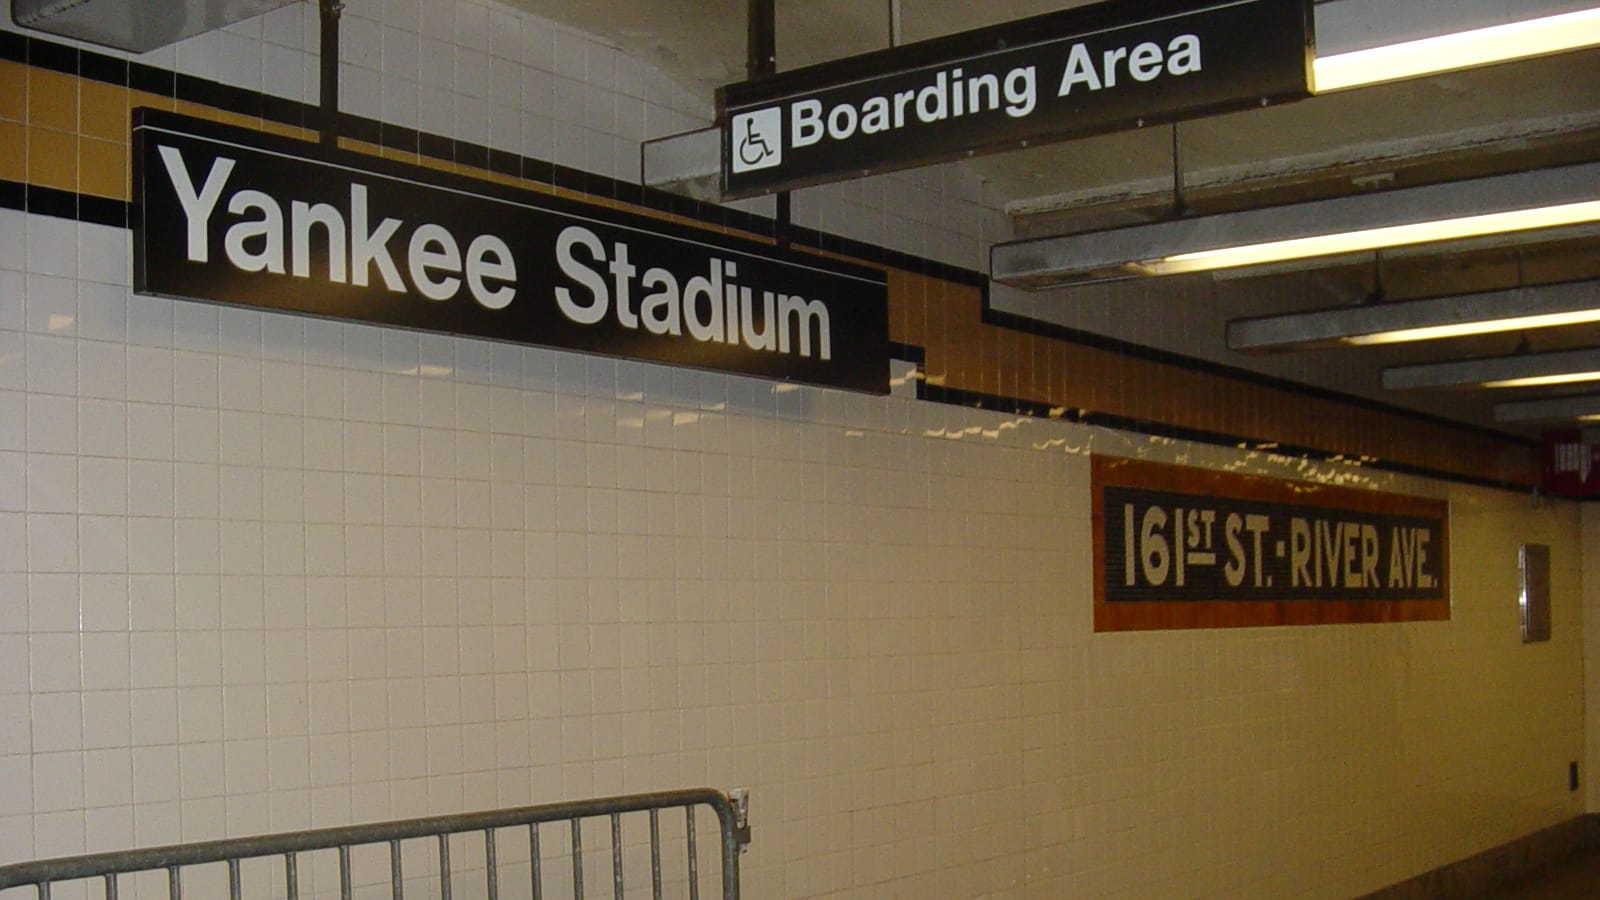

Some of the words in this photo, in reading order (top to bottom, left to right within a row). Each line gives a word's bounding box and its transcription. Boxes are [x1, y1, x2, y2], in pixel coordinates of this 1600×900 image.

[790, 65, 1037, 149] Boarding
[1057, 34, 1202, 97] Area
[157, 145, 518, 310] Yankee
[555, 226, 832, 361] Stadium
[1388, 527, 1438, 588] AVE.
